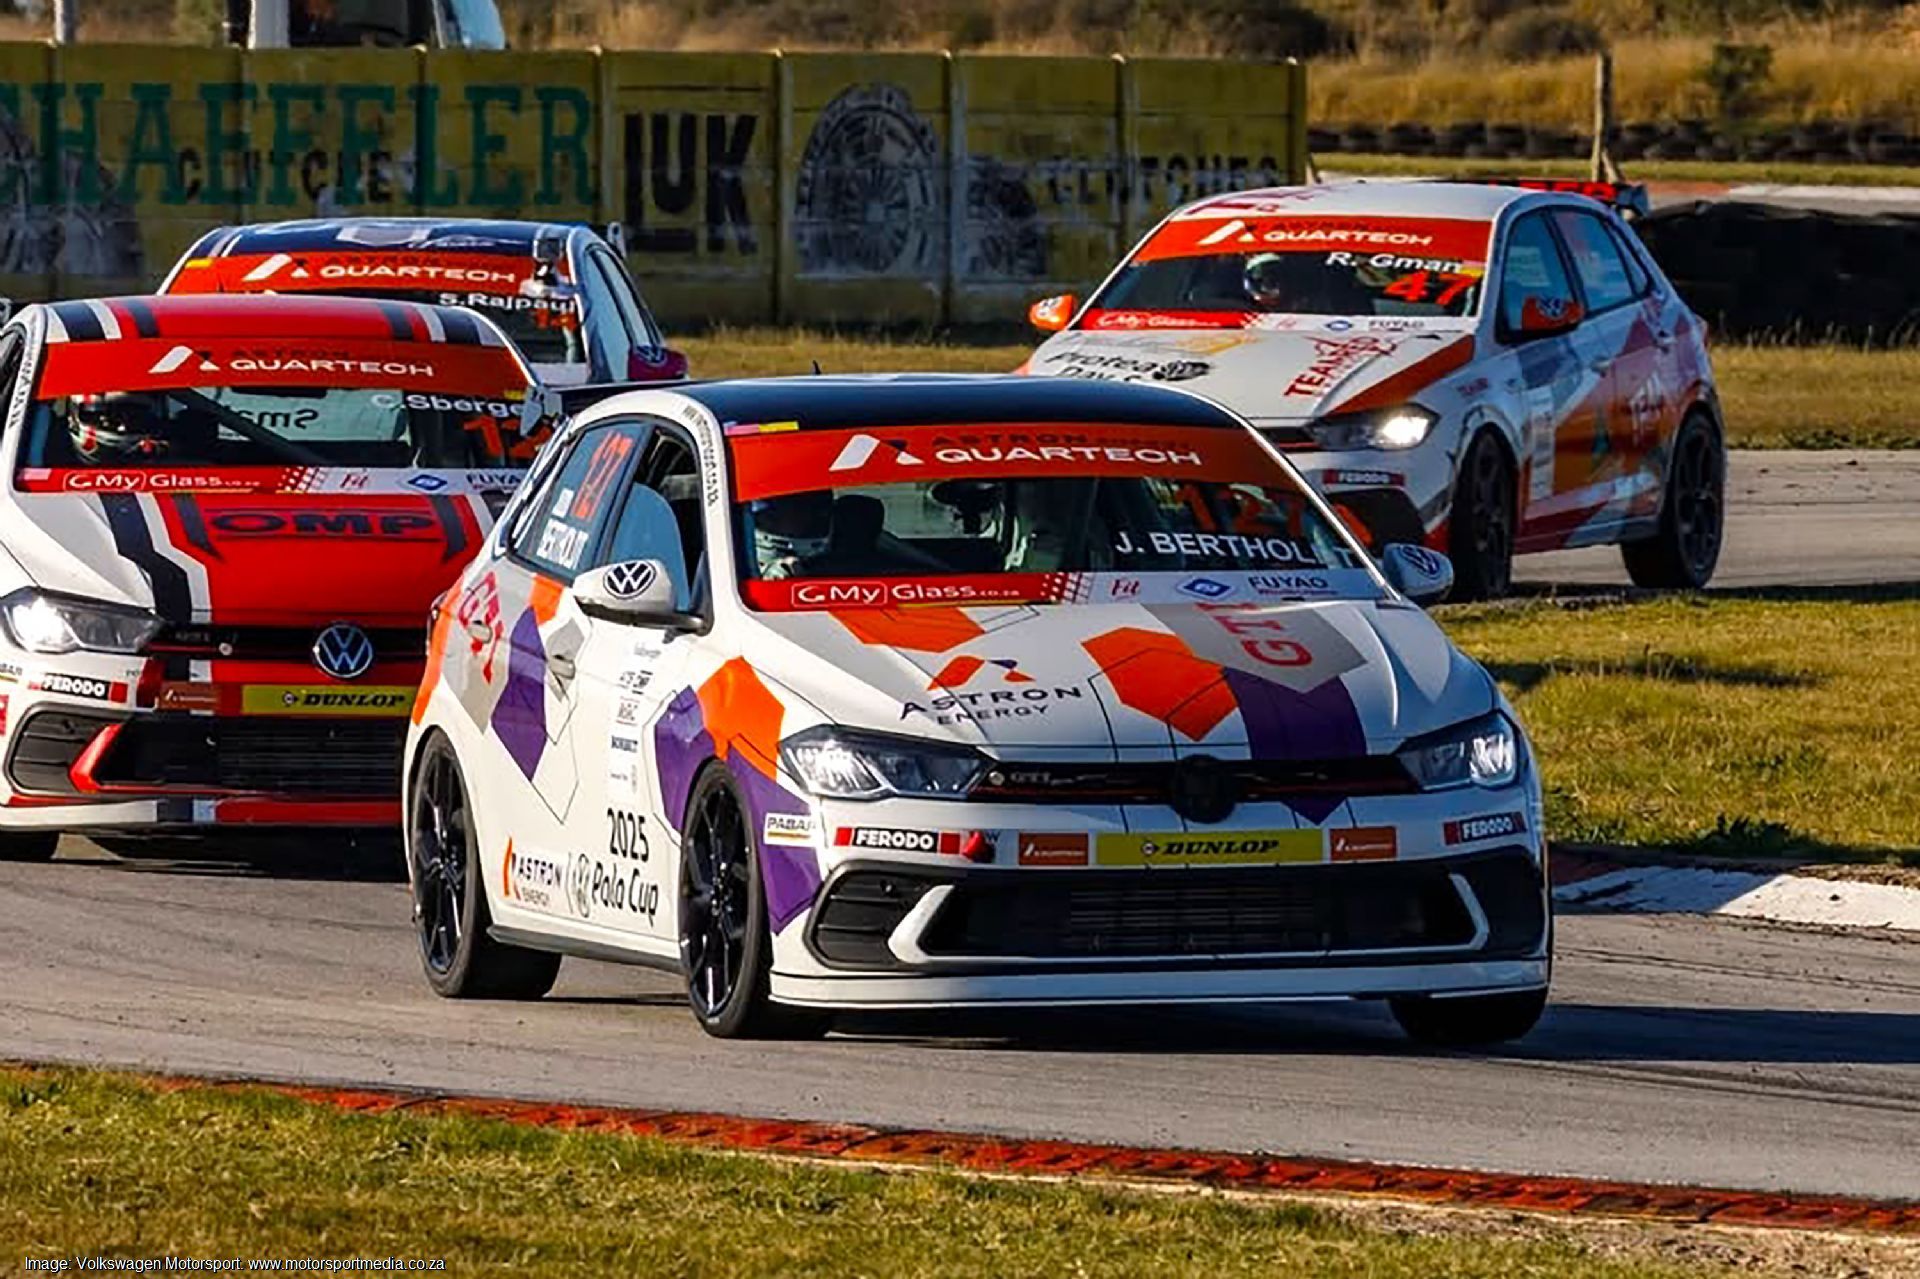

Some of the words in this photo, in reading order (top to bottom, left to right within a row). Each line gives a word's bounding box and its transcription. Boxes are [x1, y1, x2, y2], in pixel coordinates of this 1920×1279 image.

[1325, 252, 1358, 267] R.
[1370, 254, 1464, 274] Gman
[1382, 270, 1477, 306] 47
[212, 513, 434, 535] OMP
[1115, 531, 1144, 553] J.
[1248, 576, 1328, 590] FUYAO
[303, 691, 405, 708] DUNLOP
[899, 686, 1082, 720] ASTRON
[936, 704, 1050, 727] ENERGY
[607, 807, 650, 863] 2025
[855, 828, 936, 851] FERODO
[1163, 840, 1280, 857] DUNLOP
[628, 867, 659, 928] Cup
